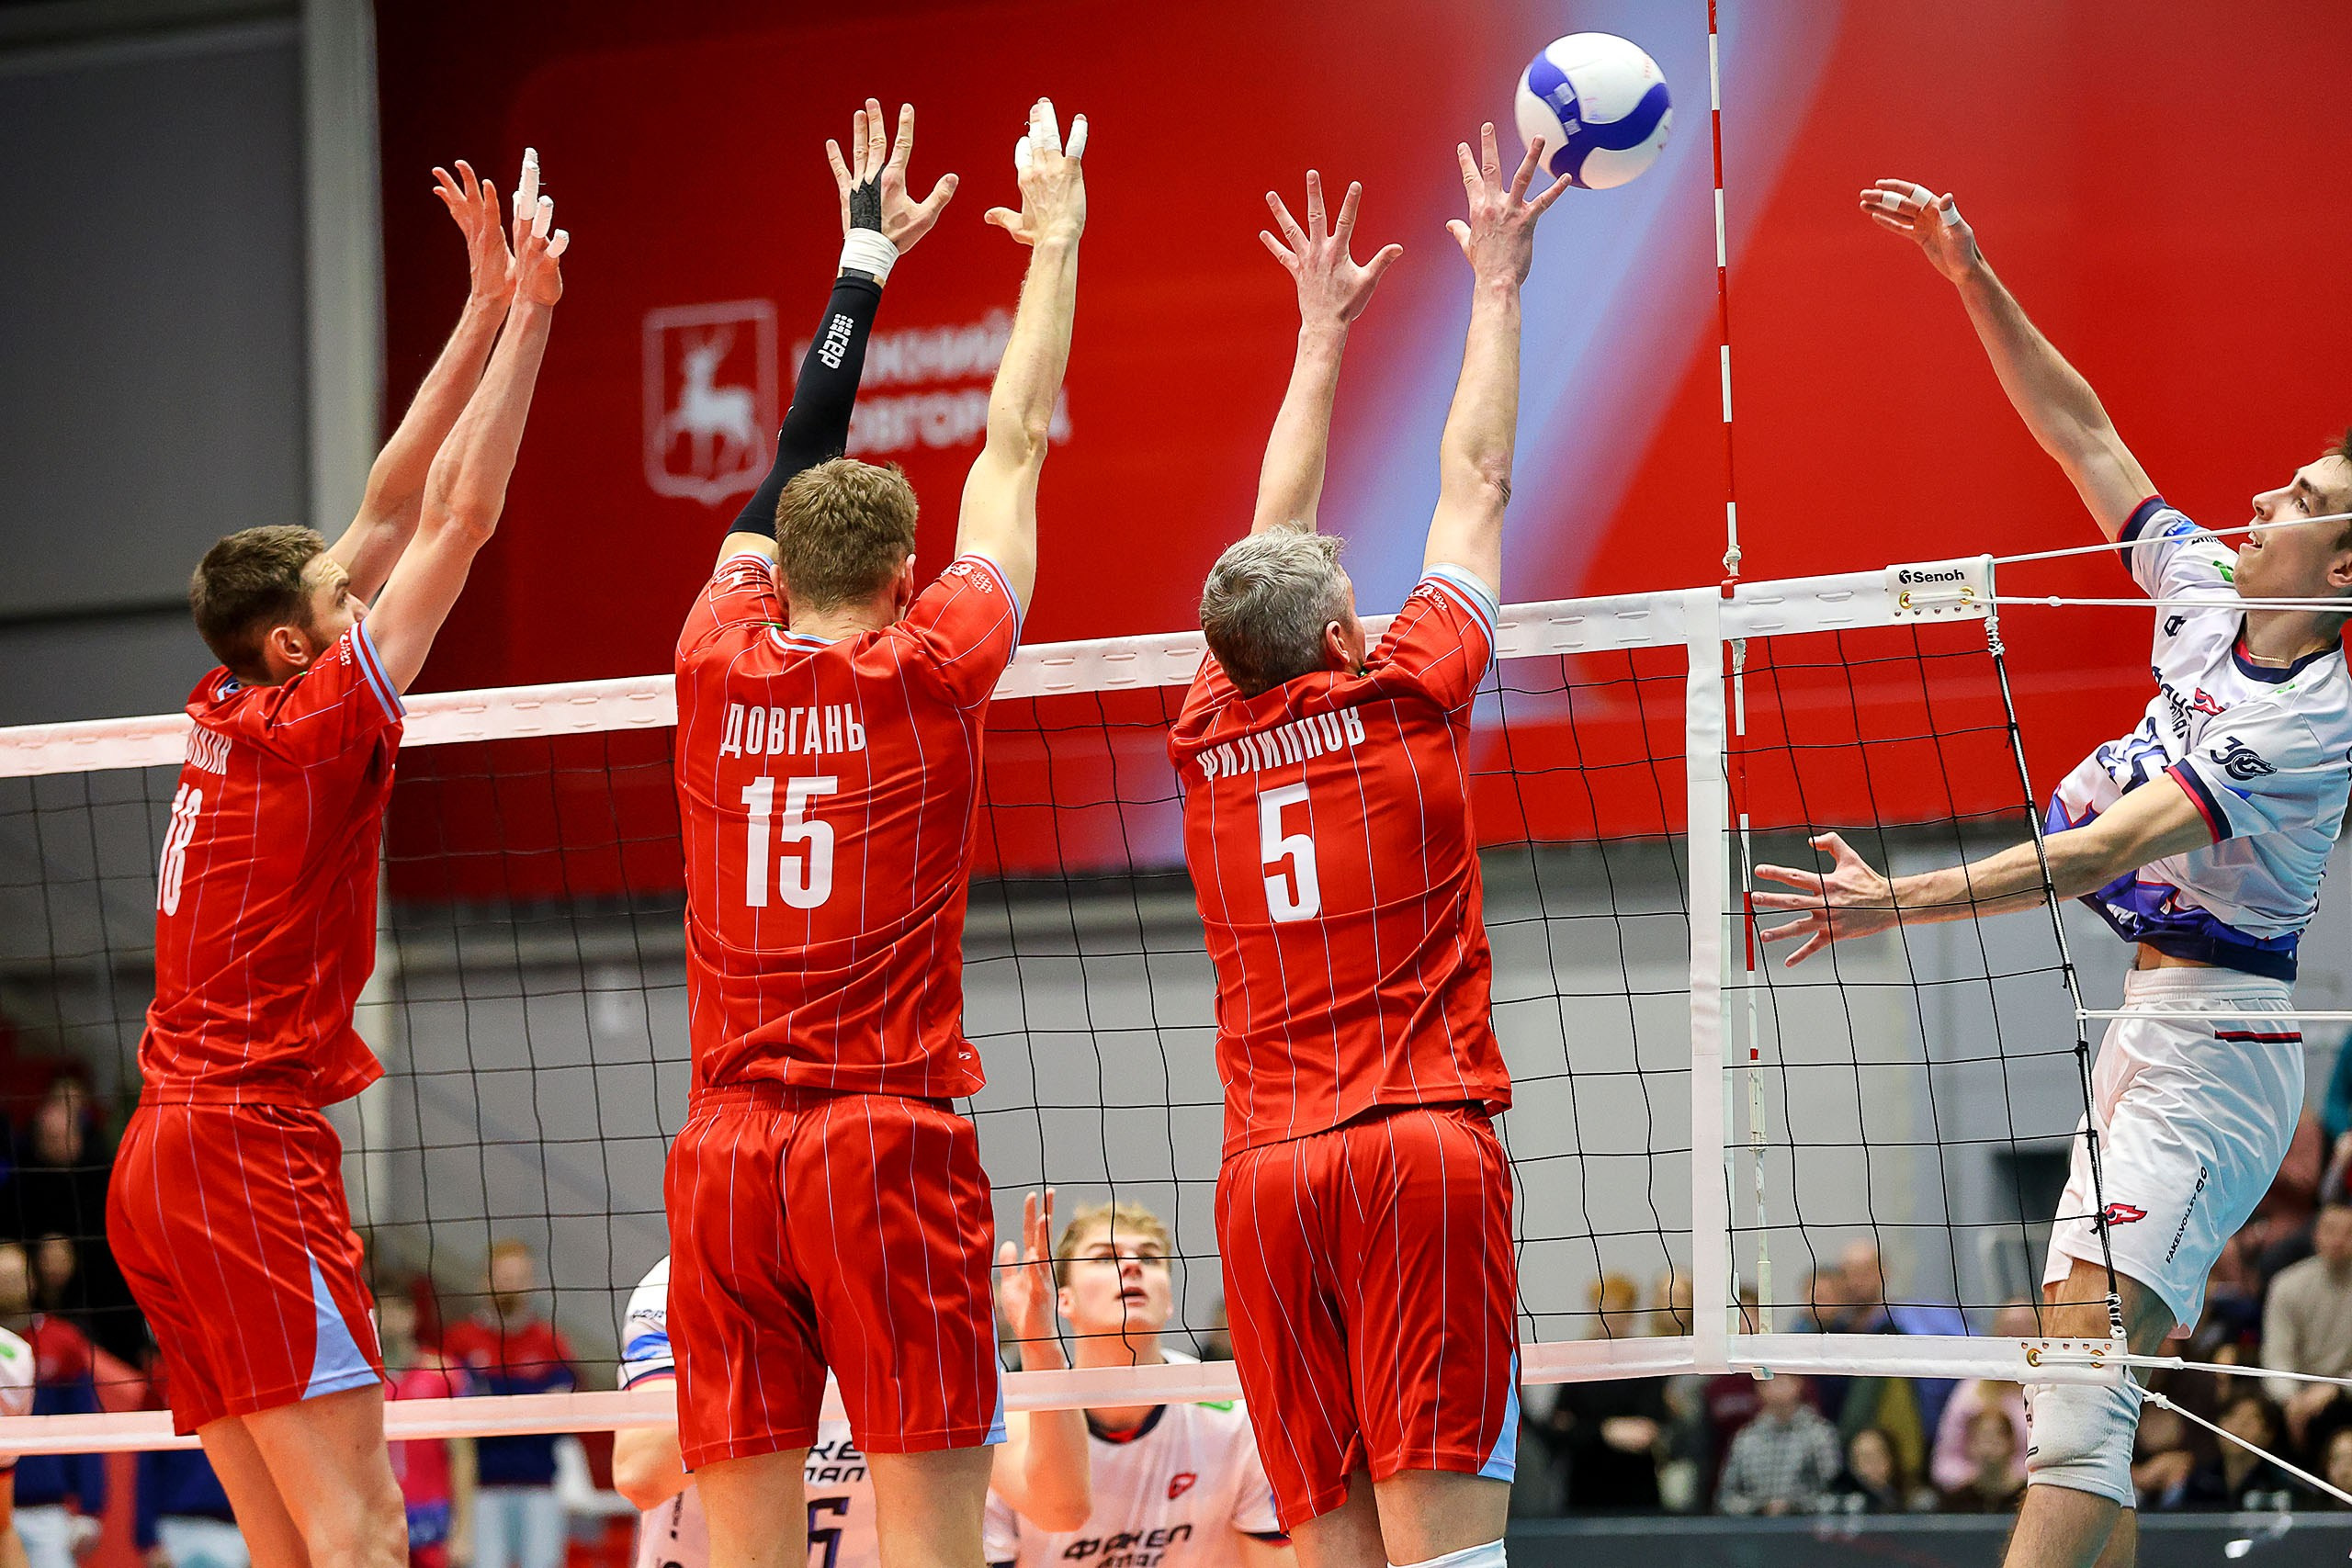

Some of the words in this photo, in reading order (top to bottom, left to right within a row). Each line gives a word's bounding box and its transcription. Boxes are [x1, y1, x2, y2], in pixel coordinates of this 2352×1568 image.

[1913, 569, 1965, 584] Senoh
[718, 703, 867, 759] ДОВГАНЬ
[156, 782, 203, 917] 18
[741, 774, 838, 909] 15
[1259, 781, 1321, 923] 5
[2165, 1192, 2197, 1264] FAKELVOLLEY
